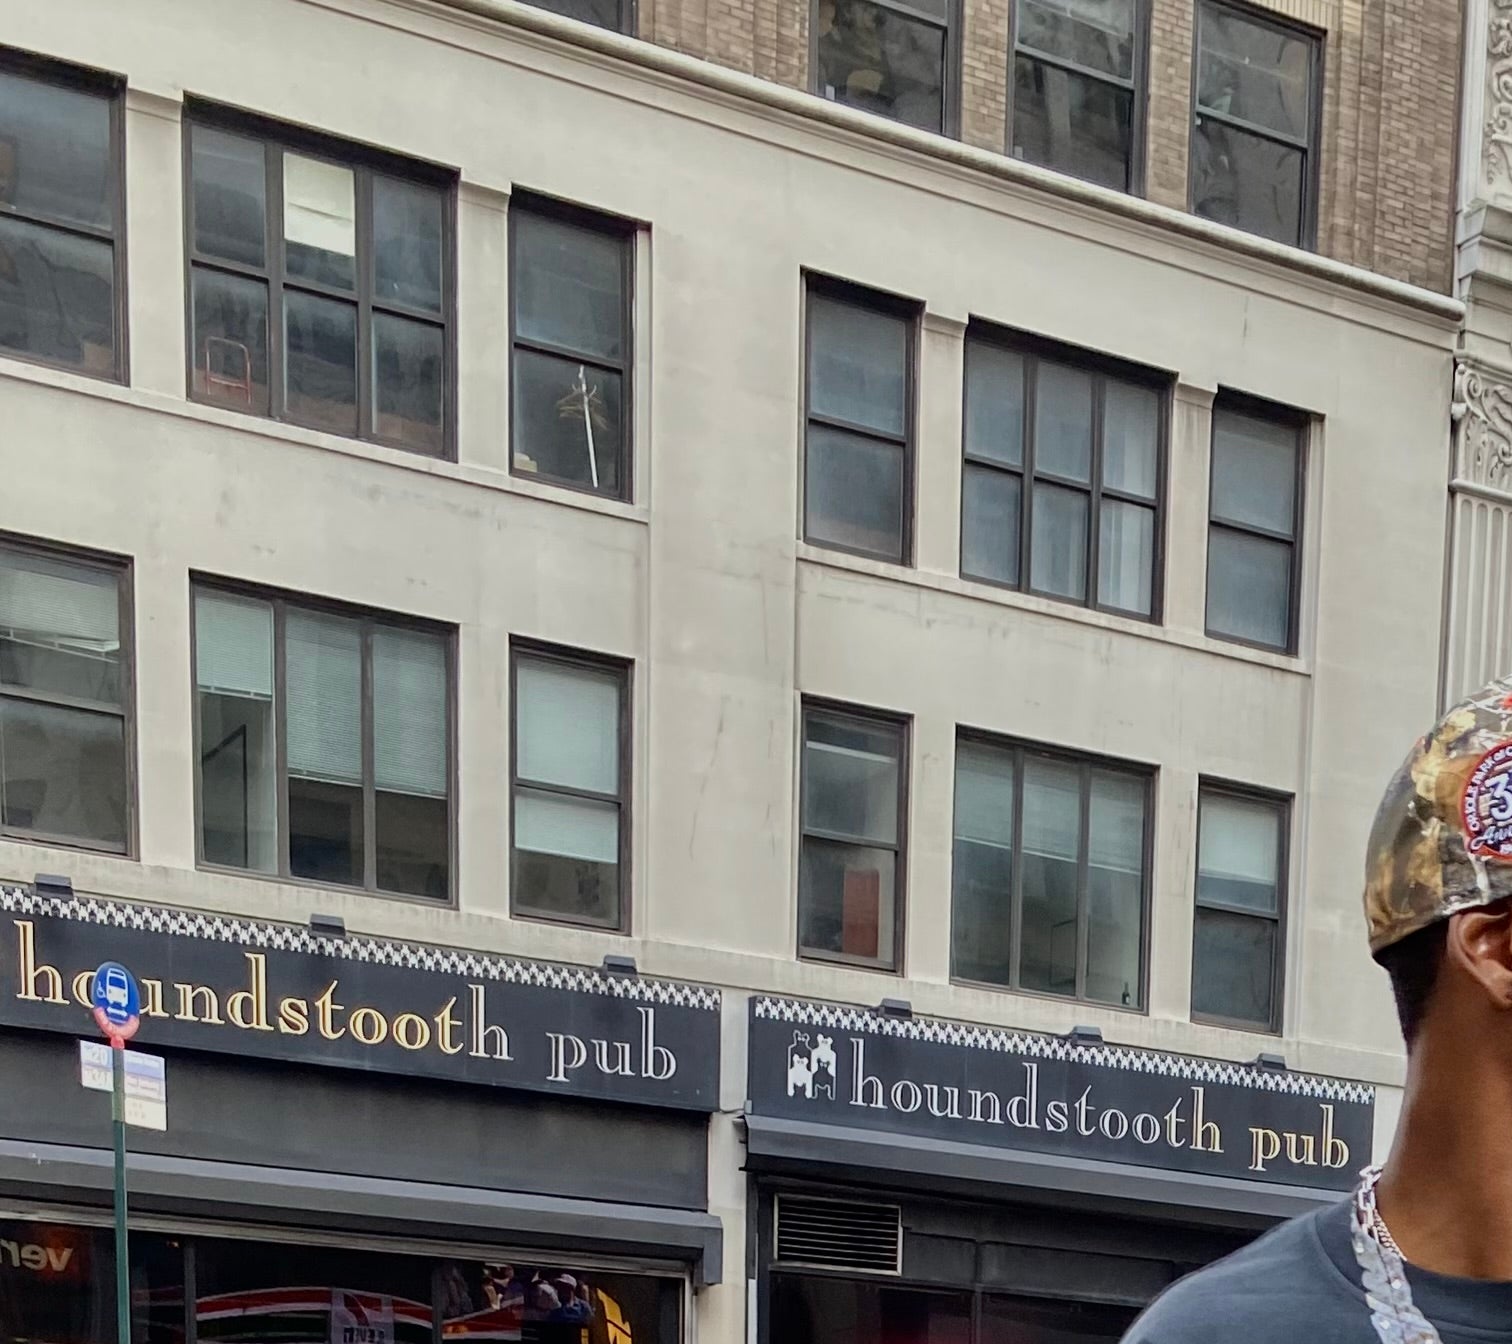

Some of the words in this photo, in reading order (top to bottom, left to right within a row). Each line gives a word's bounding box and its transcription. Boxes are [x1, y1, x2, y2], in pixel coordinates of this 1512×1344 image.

[545, 1006, 677, 1082] pub
[849, 1038, 1224, 1153] houndstooth
[1248, 1104, 1351, 1172] pub
